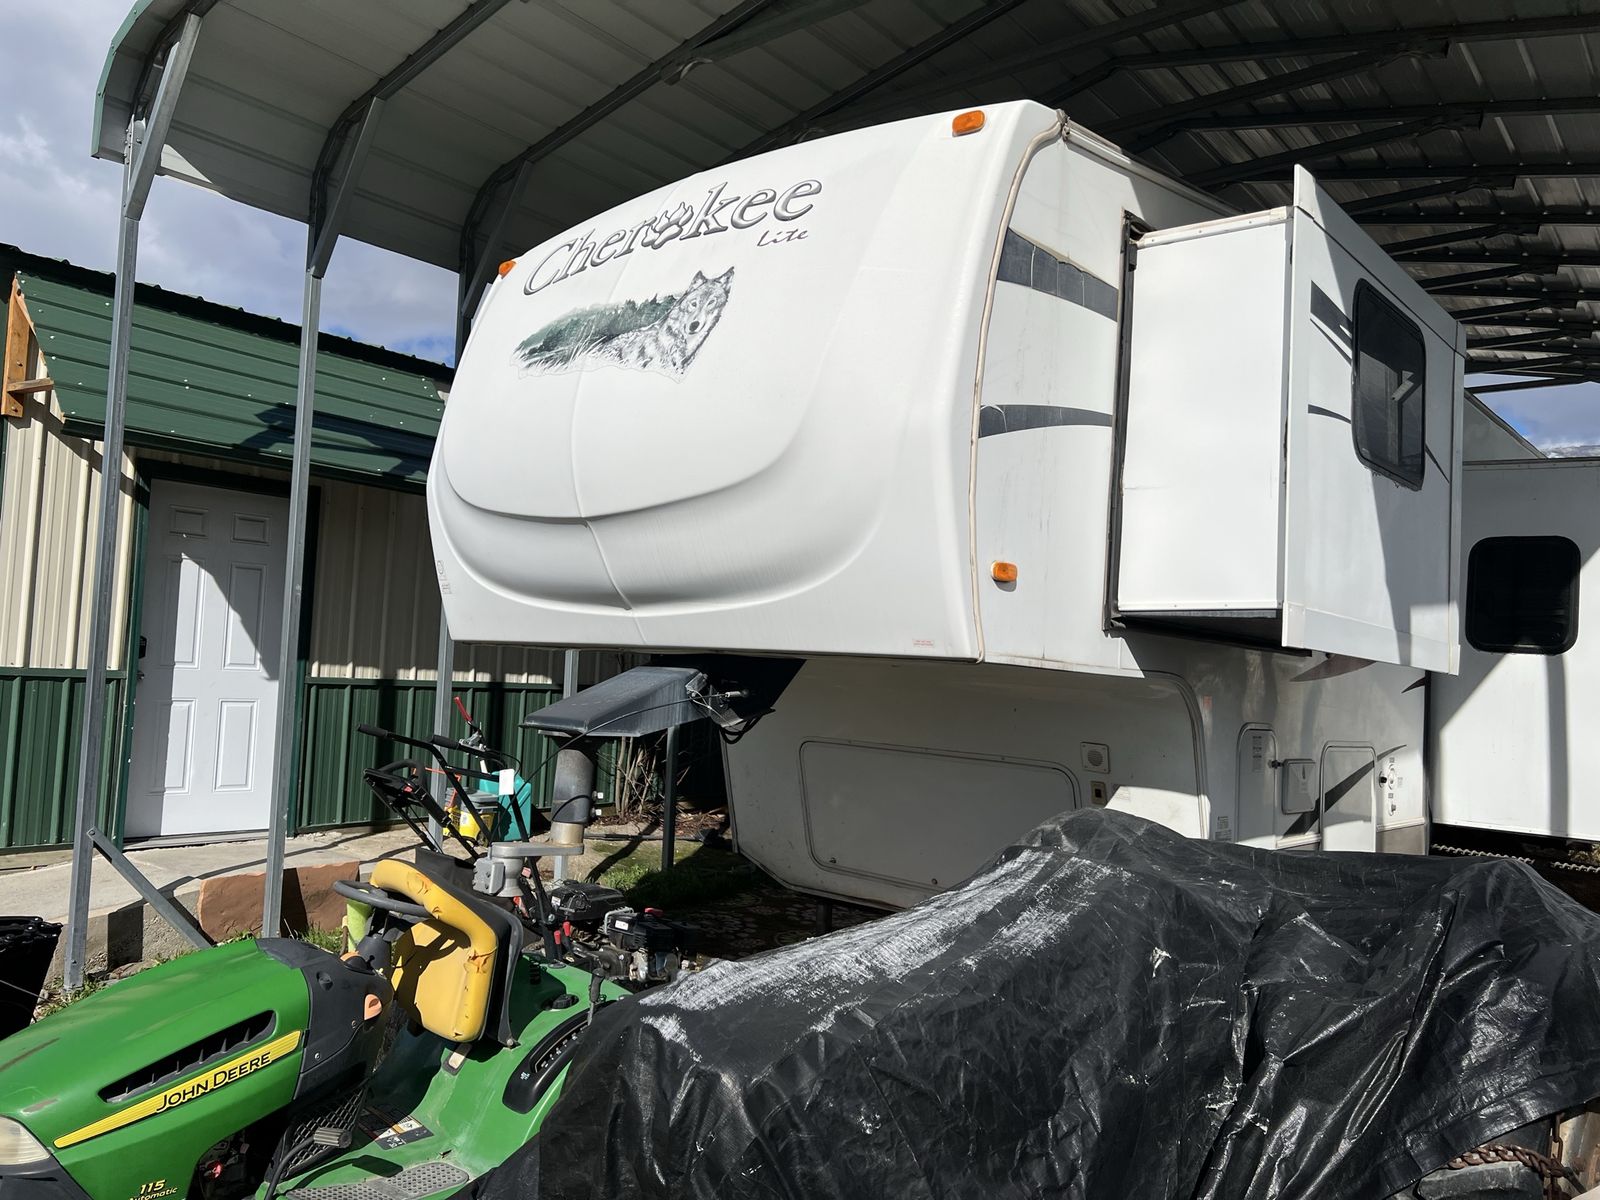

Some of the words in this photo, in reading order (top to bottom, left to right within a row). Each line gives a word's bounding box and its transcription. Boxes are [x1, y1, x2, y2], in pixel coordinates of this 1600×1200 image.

[524, 179, 822, 295] Cherokee
[156, 1079, 209, 1112] JOHN
[213, 1051, 271, 1088] DEERE
[140, 1179, 166, 1195] 115
